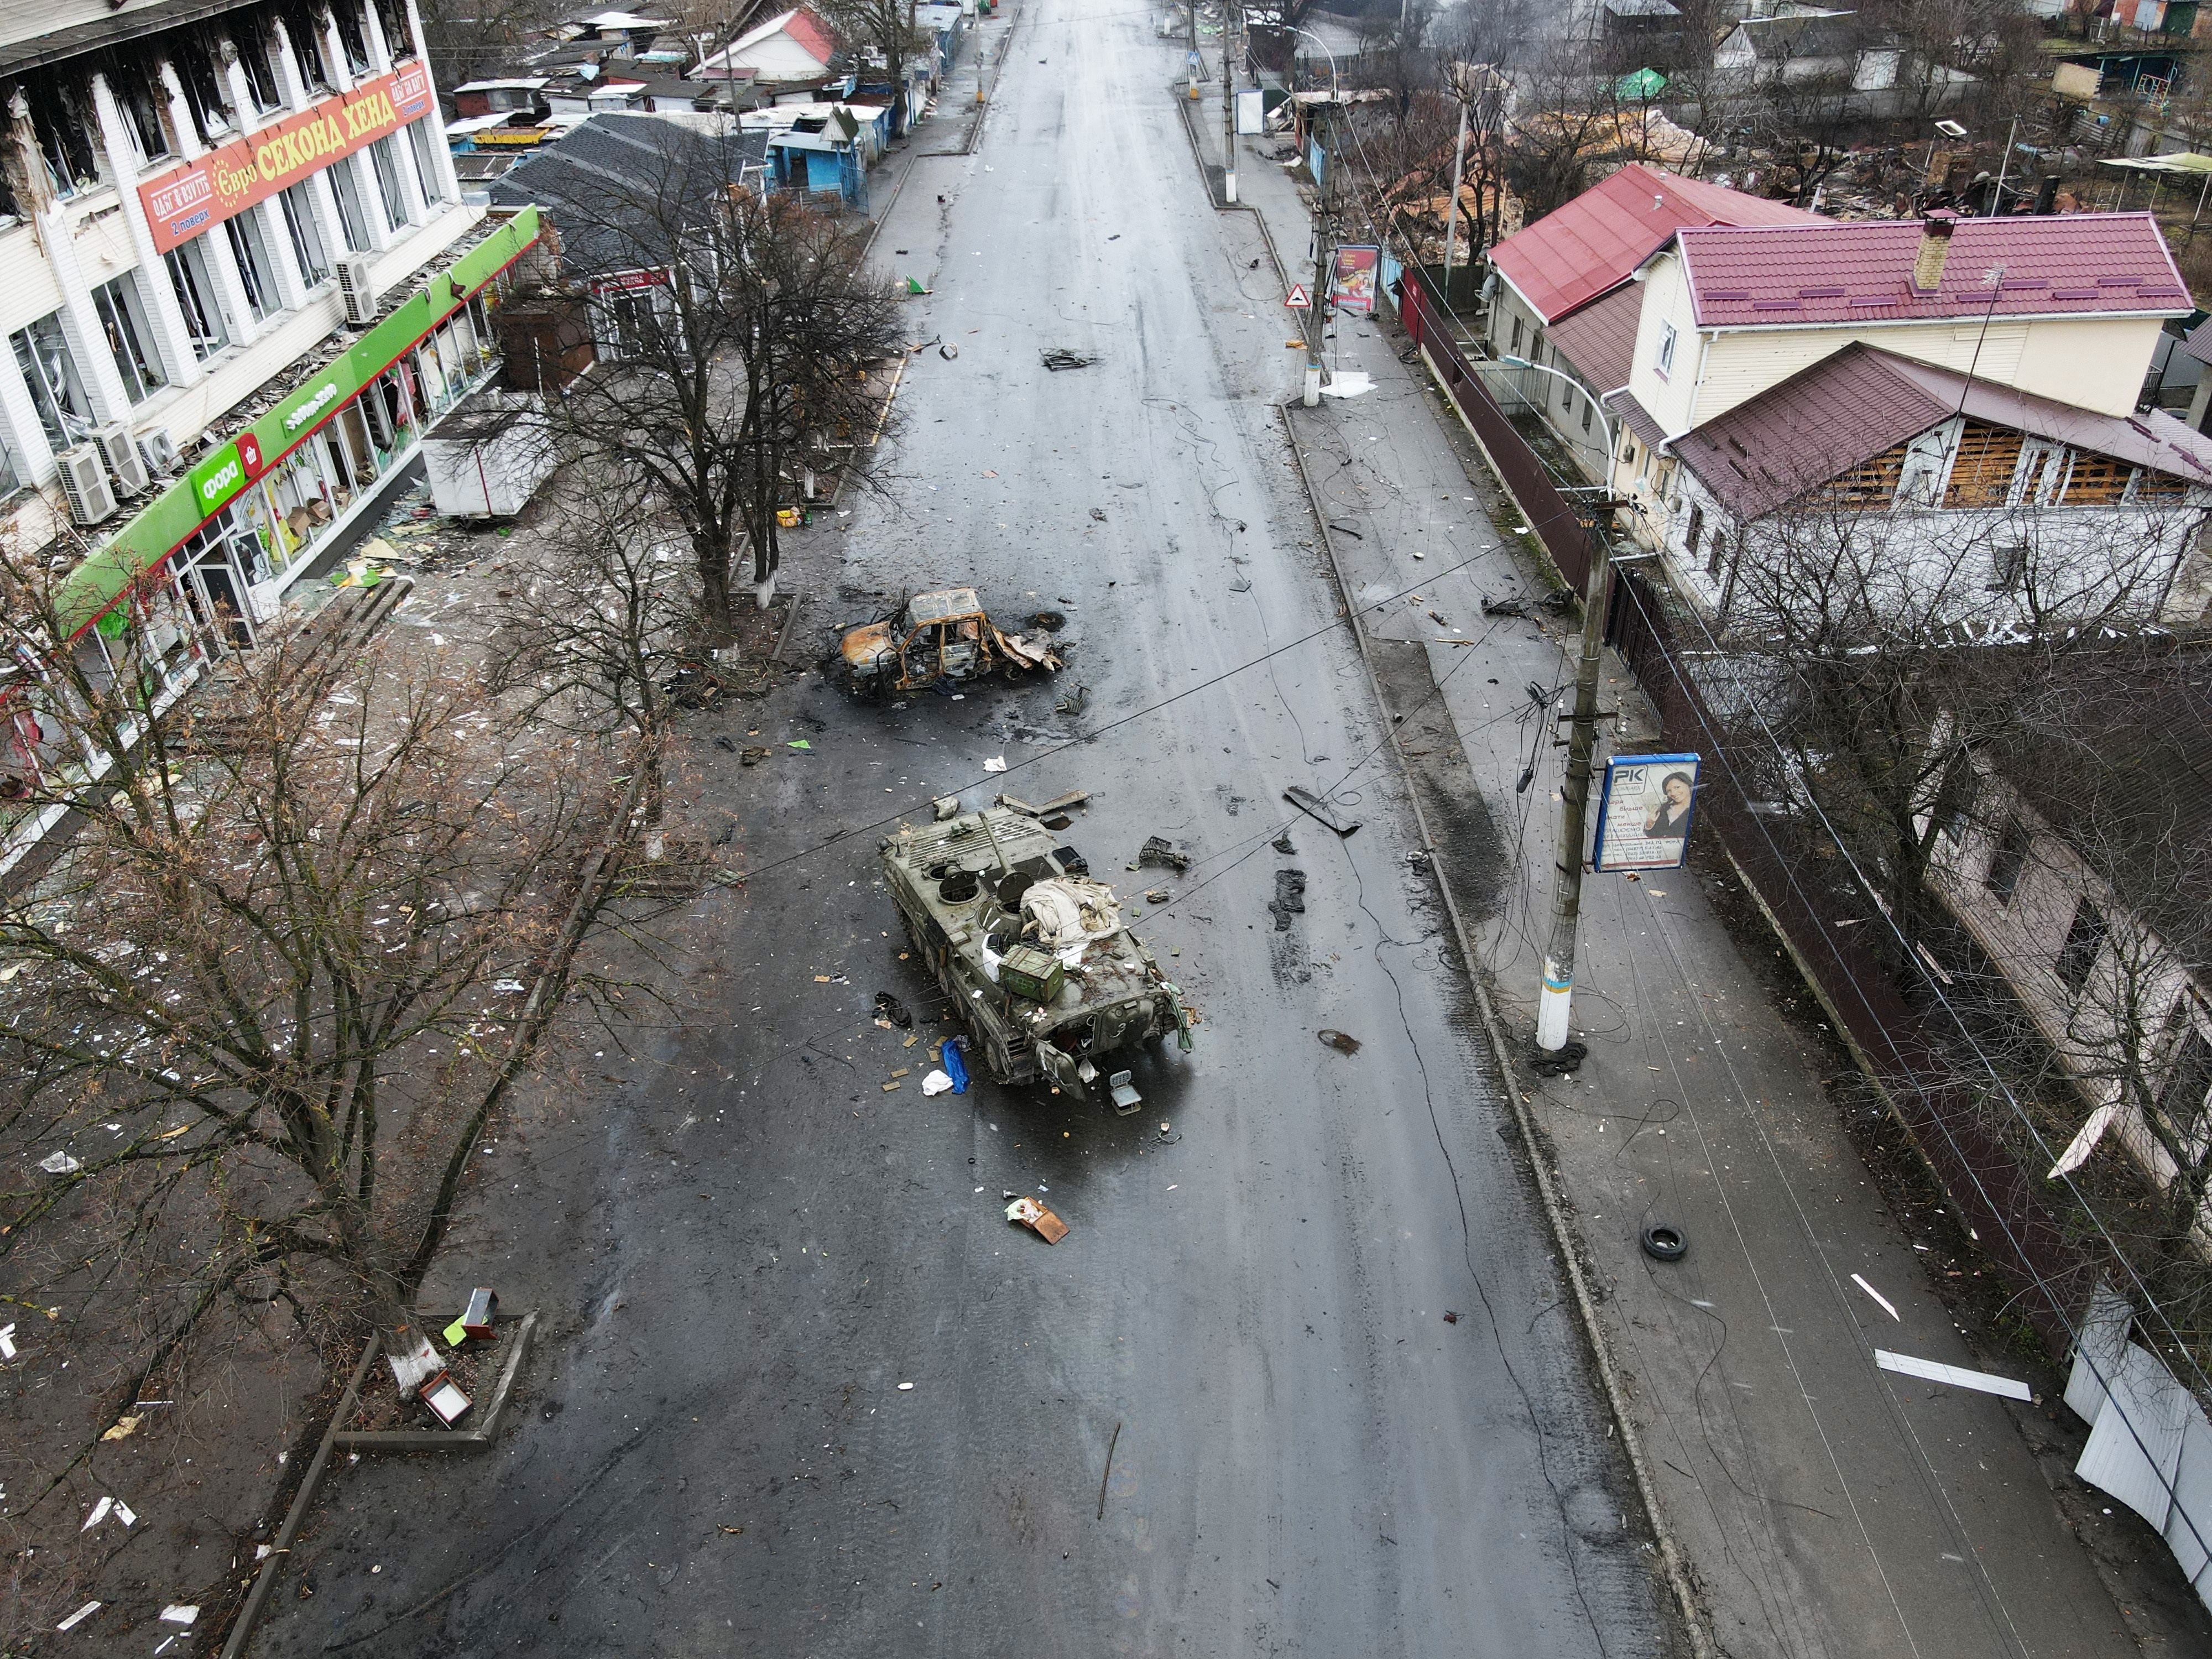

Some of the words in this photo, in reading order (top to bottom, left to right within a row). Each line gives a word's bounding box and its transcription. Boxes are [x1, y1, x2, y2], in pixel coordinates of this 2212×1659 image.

[218, 164, 257, 195] Євро
[258, 114, 346, 181] СЕКОНД
[342, 90, 396, 140] ХЕНД
[153, 192, 174, 217] ОДЯГ
[181, 175, 211, 204] ВЗУТТЯ
[171, 222, 180, 237] 2
[179, 208, 211, 232] поверх
